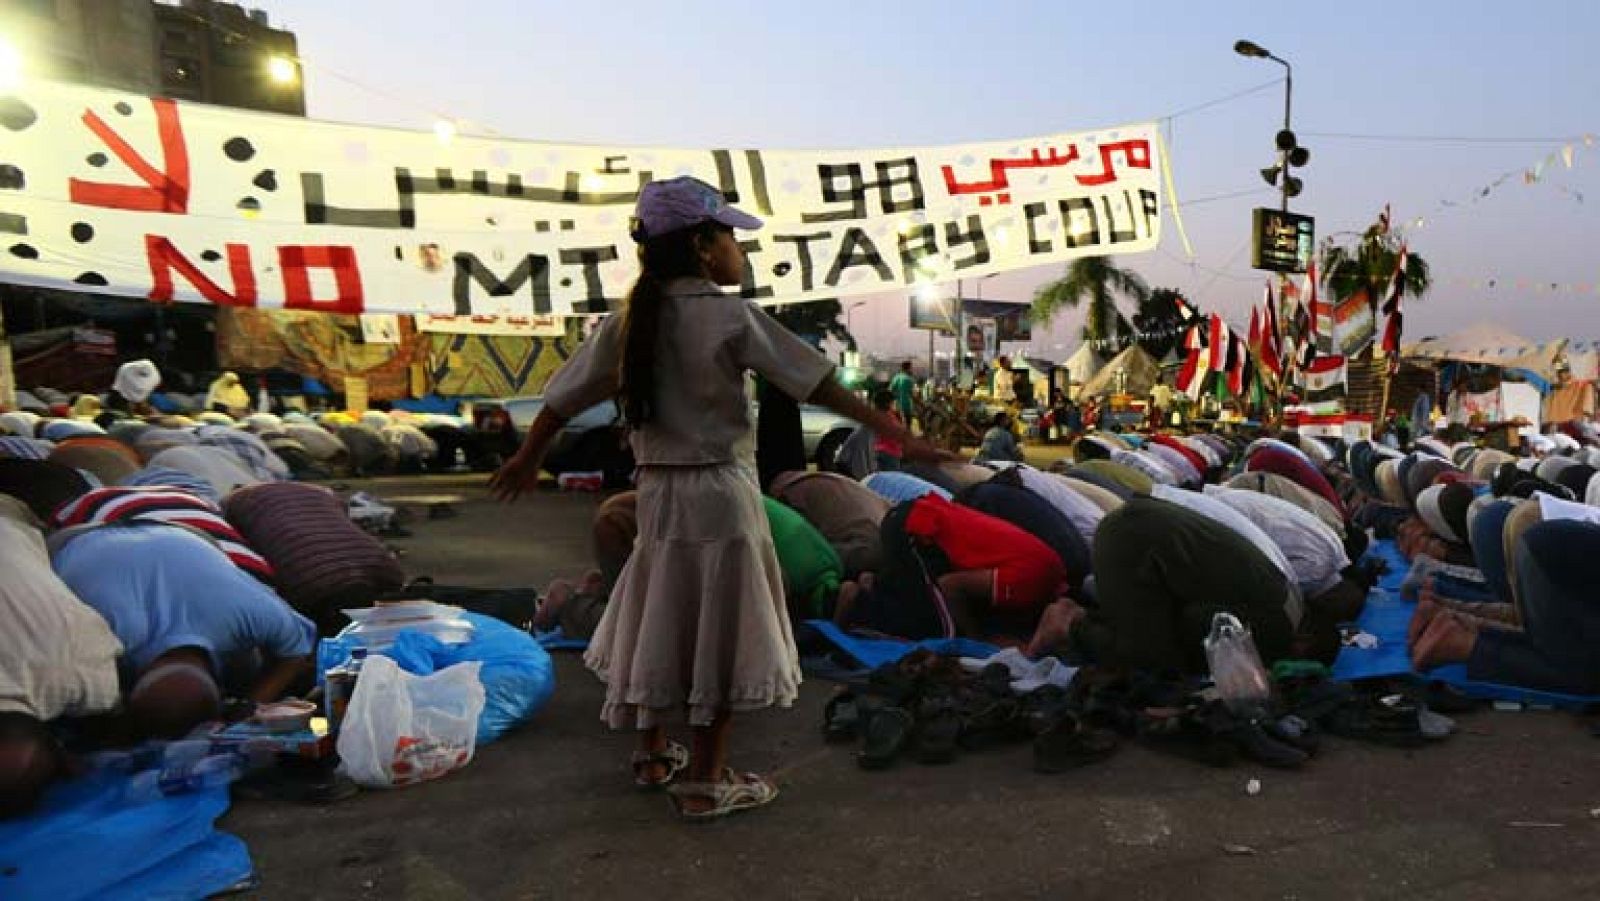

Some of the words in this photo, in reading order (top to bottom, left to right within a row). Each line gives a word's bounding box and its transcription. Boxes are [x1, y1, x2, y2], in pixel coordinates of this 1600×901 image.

[68, 95, 190, 214] لا
[802, 156, 926, 223] هو
[941, 139, 1151, 206] مرسي
[145, 233, 364, 314] NO
[452, 214, 990, 315] MIITARY
[1023, 189, 1157, 255] COUP
